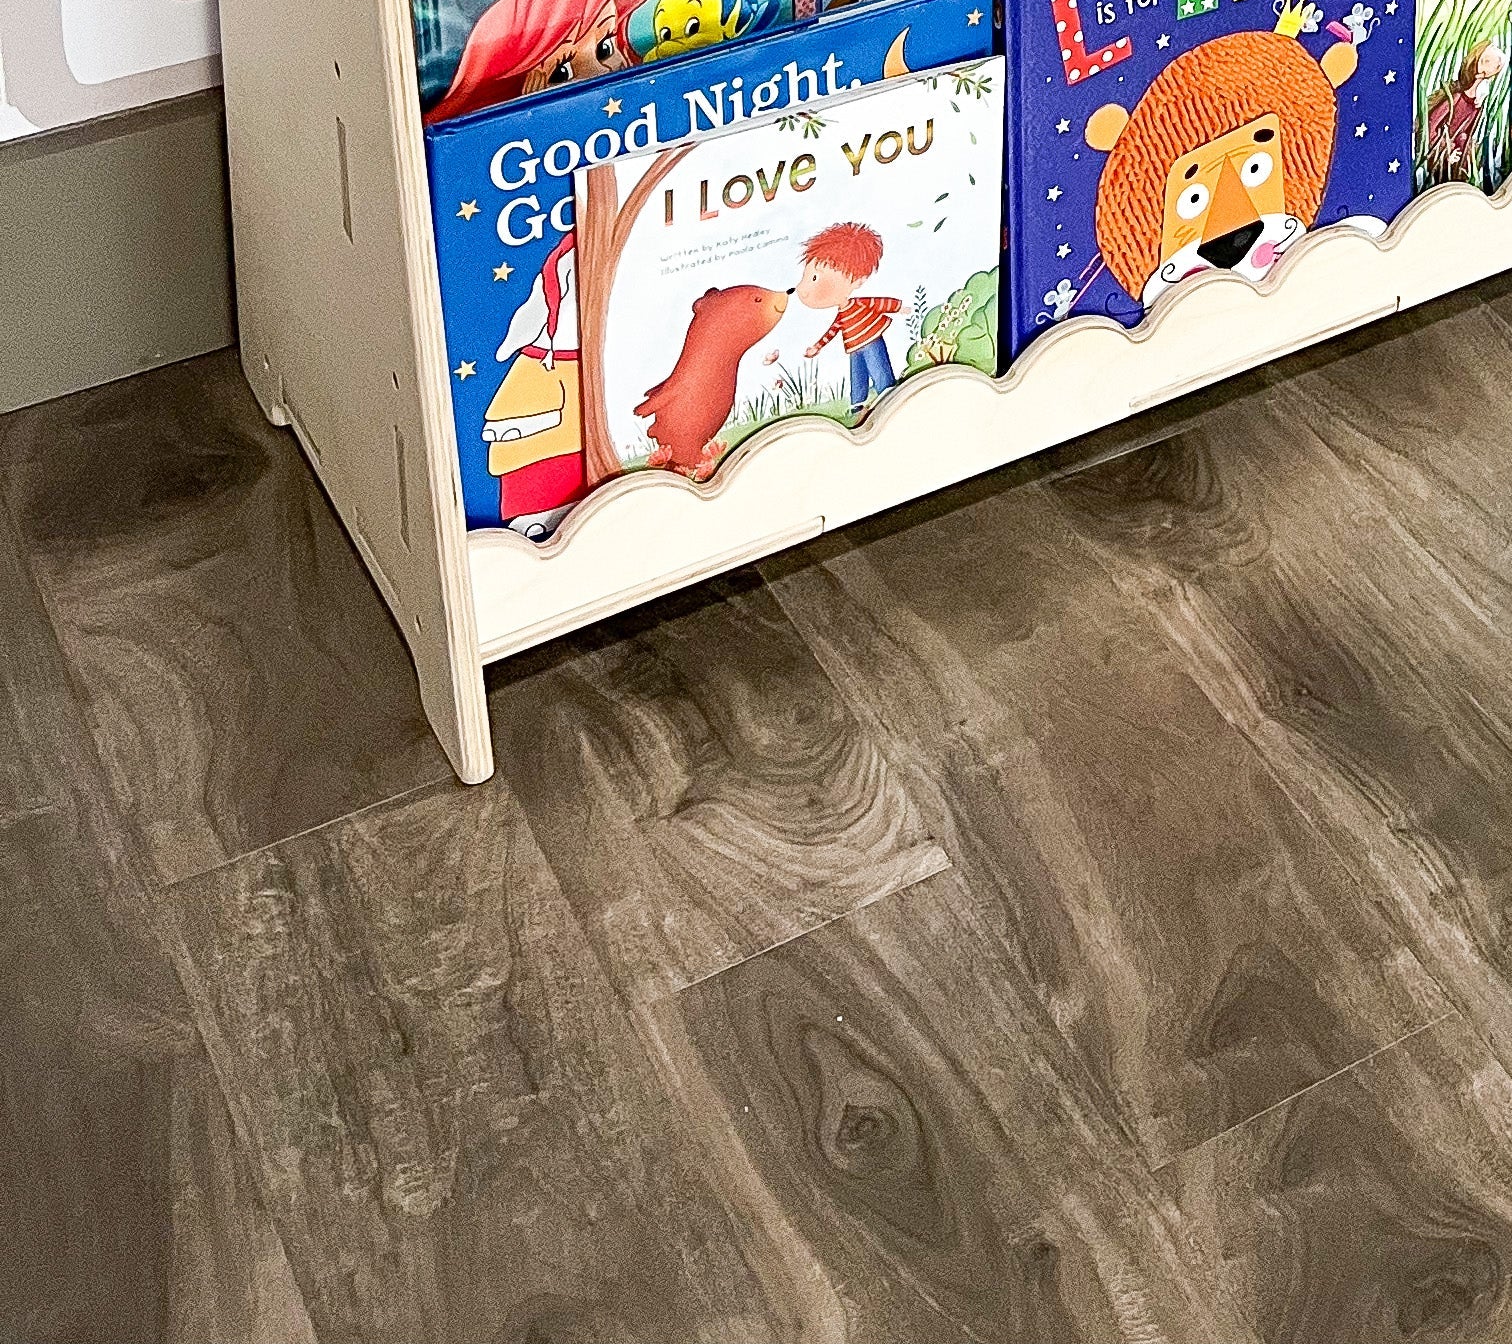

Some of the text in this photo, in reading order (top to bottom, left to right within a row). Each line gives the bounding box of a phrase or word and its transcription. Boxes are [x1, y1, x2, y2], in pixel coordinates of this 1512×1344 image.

[1096, 0, 1117, 25] is
[489, 101, 666, 192] Good
[664, 188, 674, 226] I
[840, 118, 935, 177] YOU
[496, 194, 576, 247] Go
